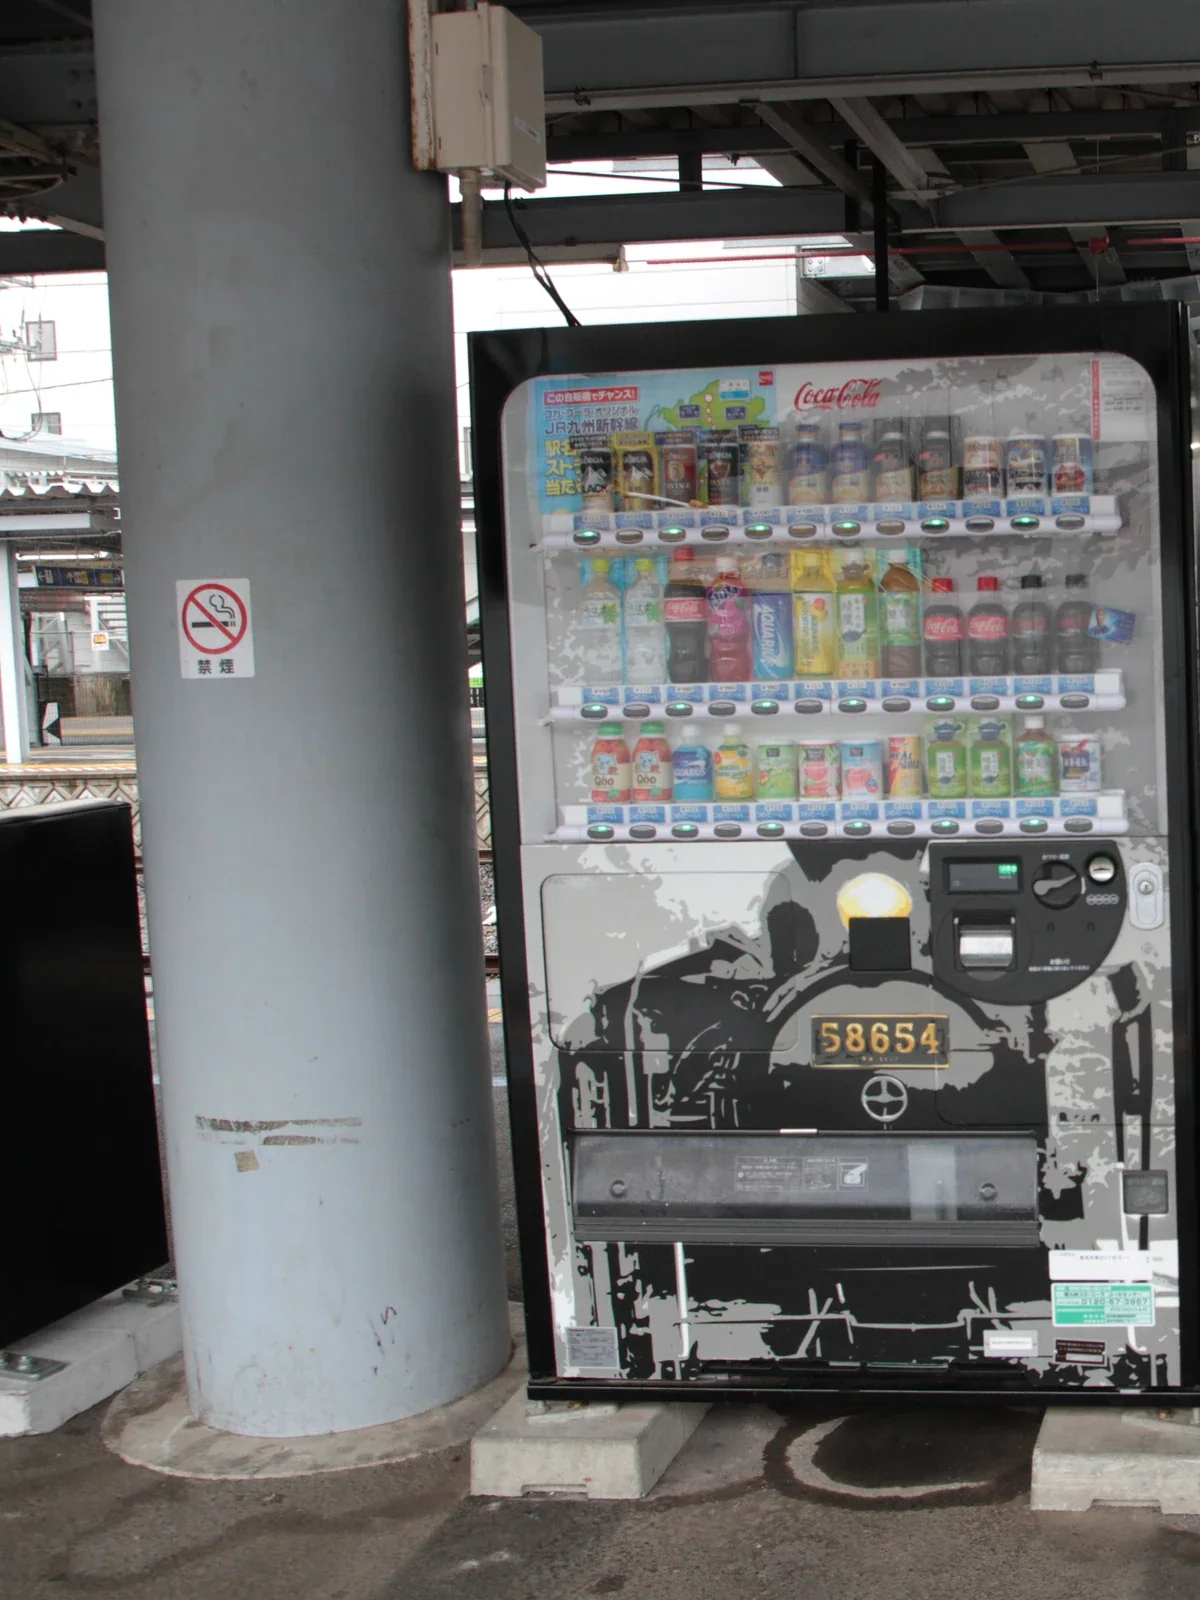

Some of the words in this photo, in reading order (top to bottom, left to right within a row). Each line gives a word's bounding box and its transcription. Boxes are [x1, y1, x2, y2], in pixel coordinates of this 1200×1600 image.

[197, 658, 235, 675] 禁煙
[594, 776, 615, 786] Qoo
[636, 774, 657, 785] Qoo
[820, 1022, 940, 1054] 58654
